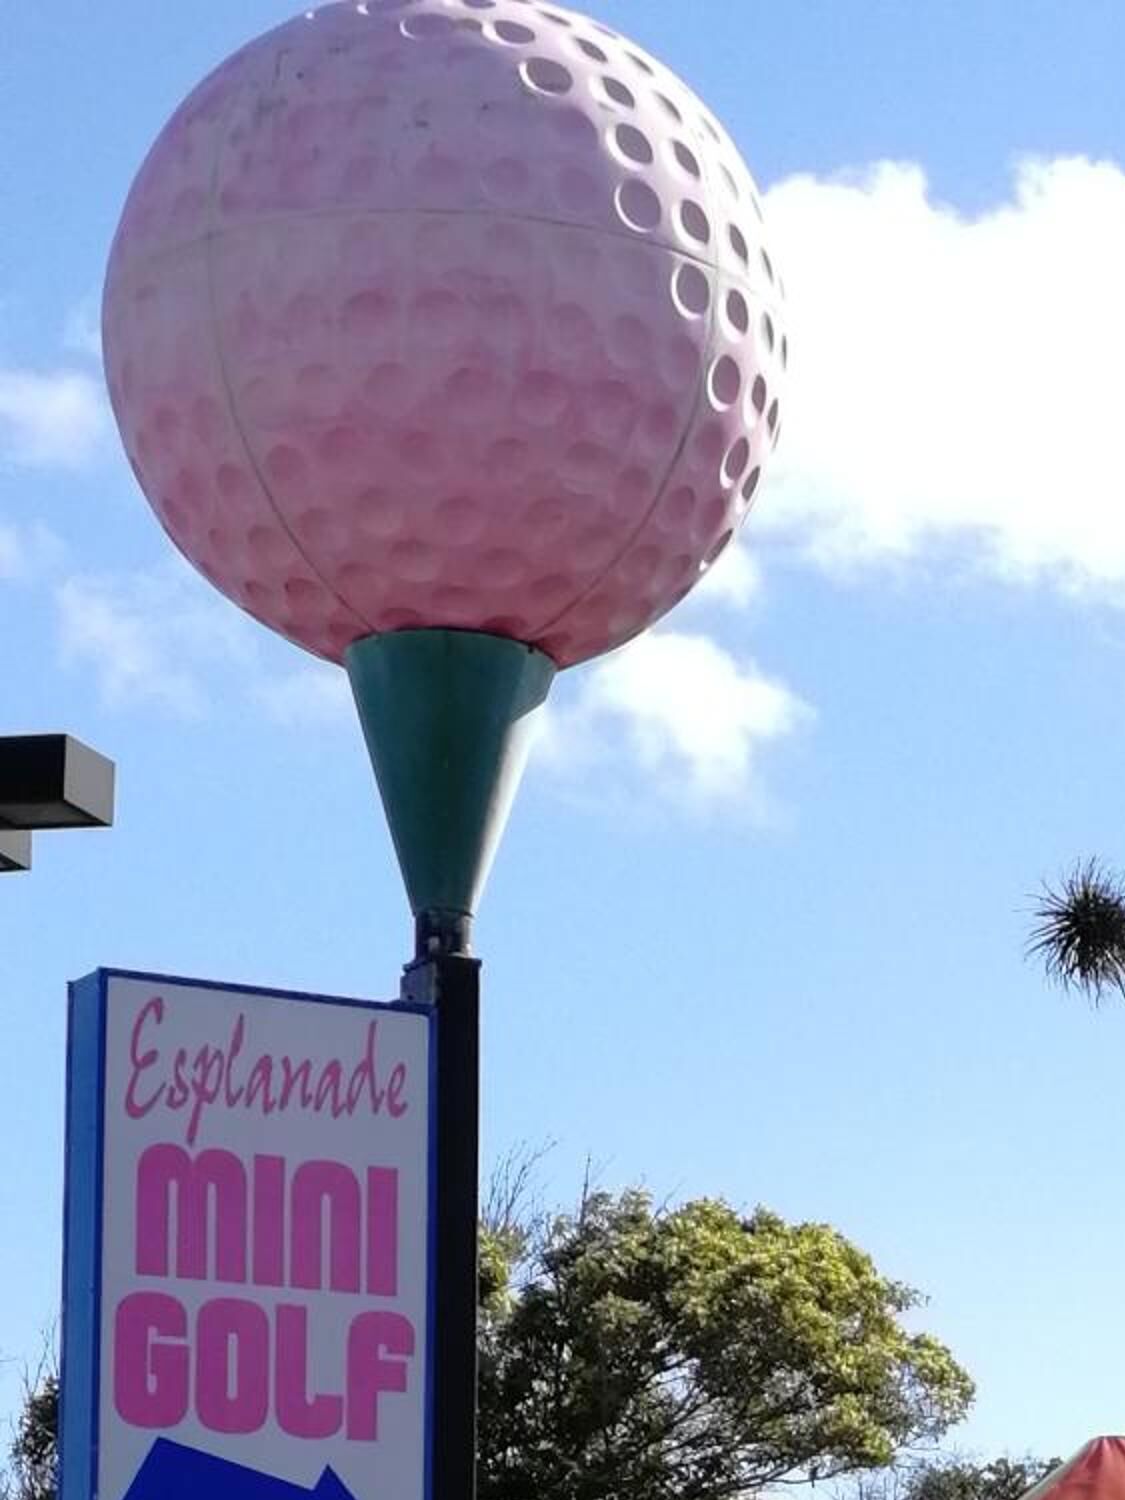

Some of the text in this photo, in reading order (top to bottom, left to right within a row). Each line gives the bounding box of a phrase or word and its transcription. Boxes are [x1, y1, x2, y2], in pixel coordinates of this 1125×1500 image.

[125, 996, 408, 1145] Esplanade
[135, 1142, 399, 1297] MINI
[113, 1290, 416, 1442] GOLF
